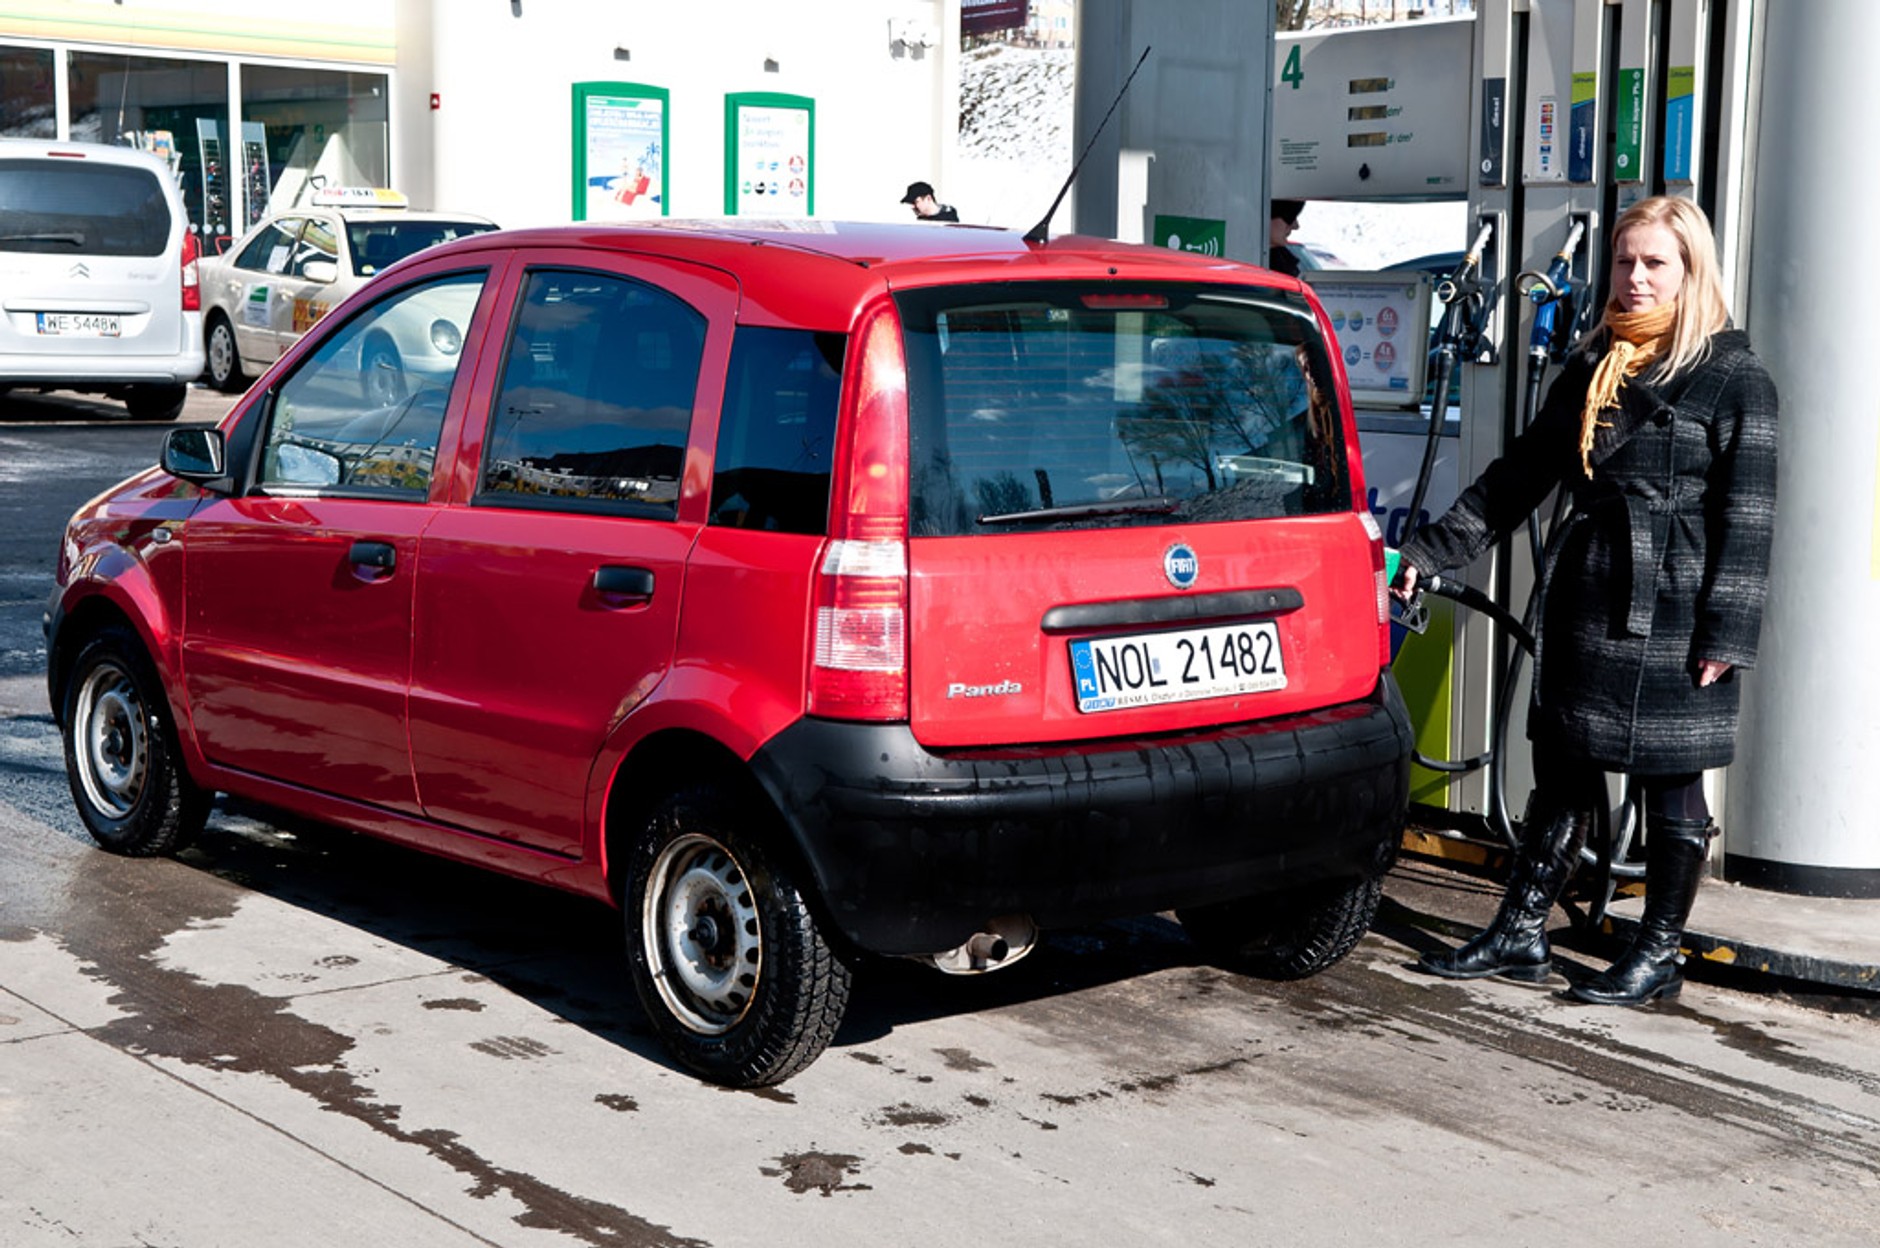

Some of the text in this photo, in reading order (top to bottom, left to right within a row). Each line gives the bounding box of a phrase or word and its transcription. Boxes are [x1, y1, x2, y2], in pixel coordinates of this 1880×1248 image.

[1281, 44, 1304, 89] 4
[1491, 97, 1500, 127] diesel
[47, 315, 69, 331] WE
[1172, 558, 1194, 574] FIAT
[1094, 630, 1277, 693] NOL 21482
[946, 680, 1022, 698] Panda
[1080, 678, 1096, 693] PL
